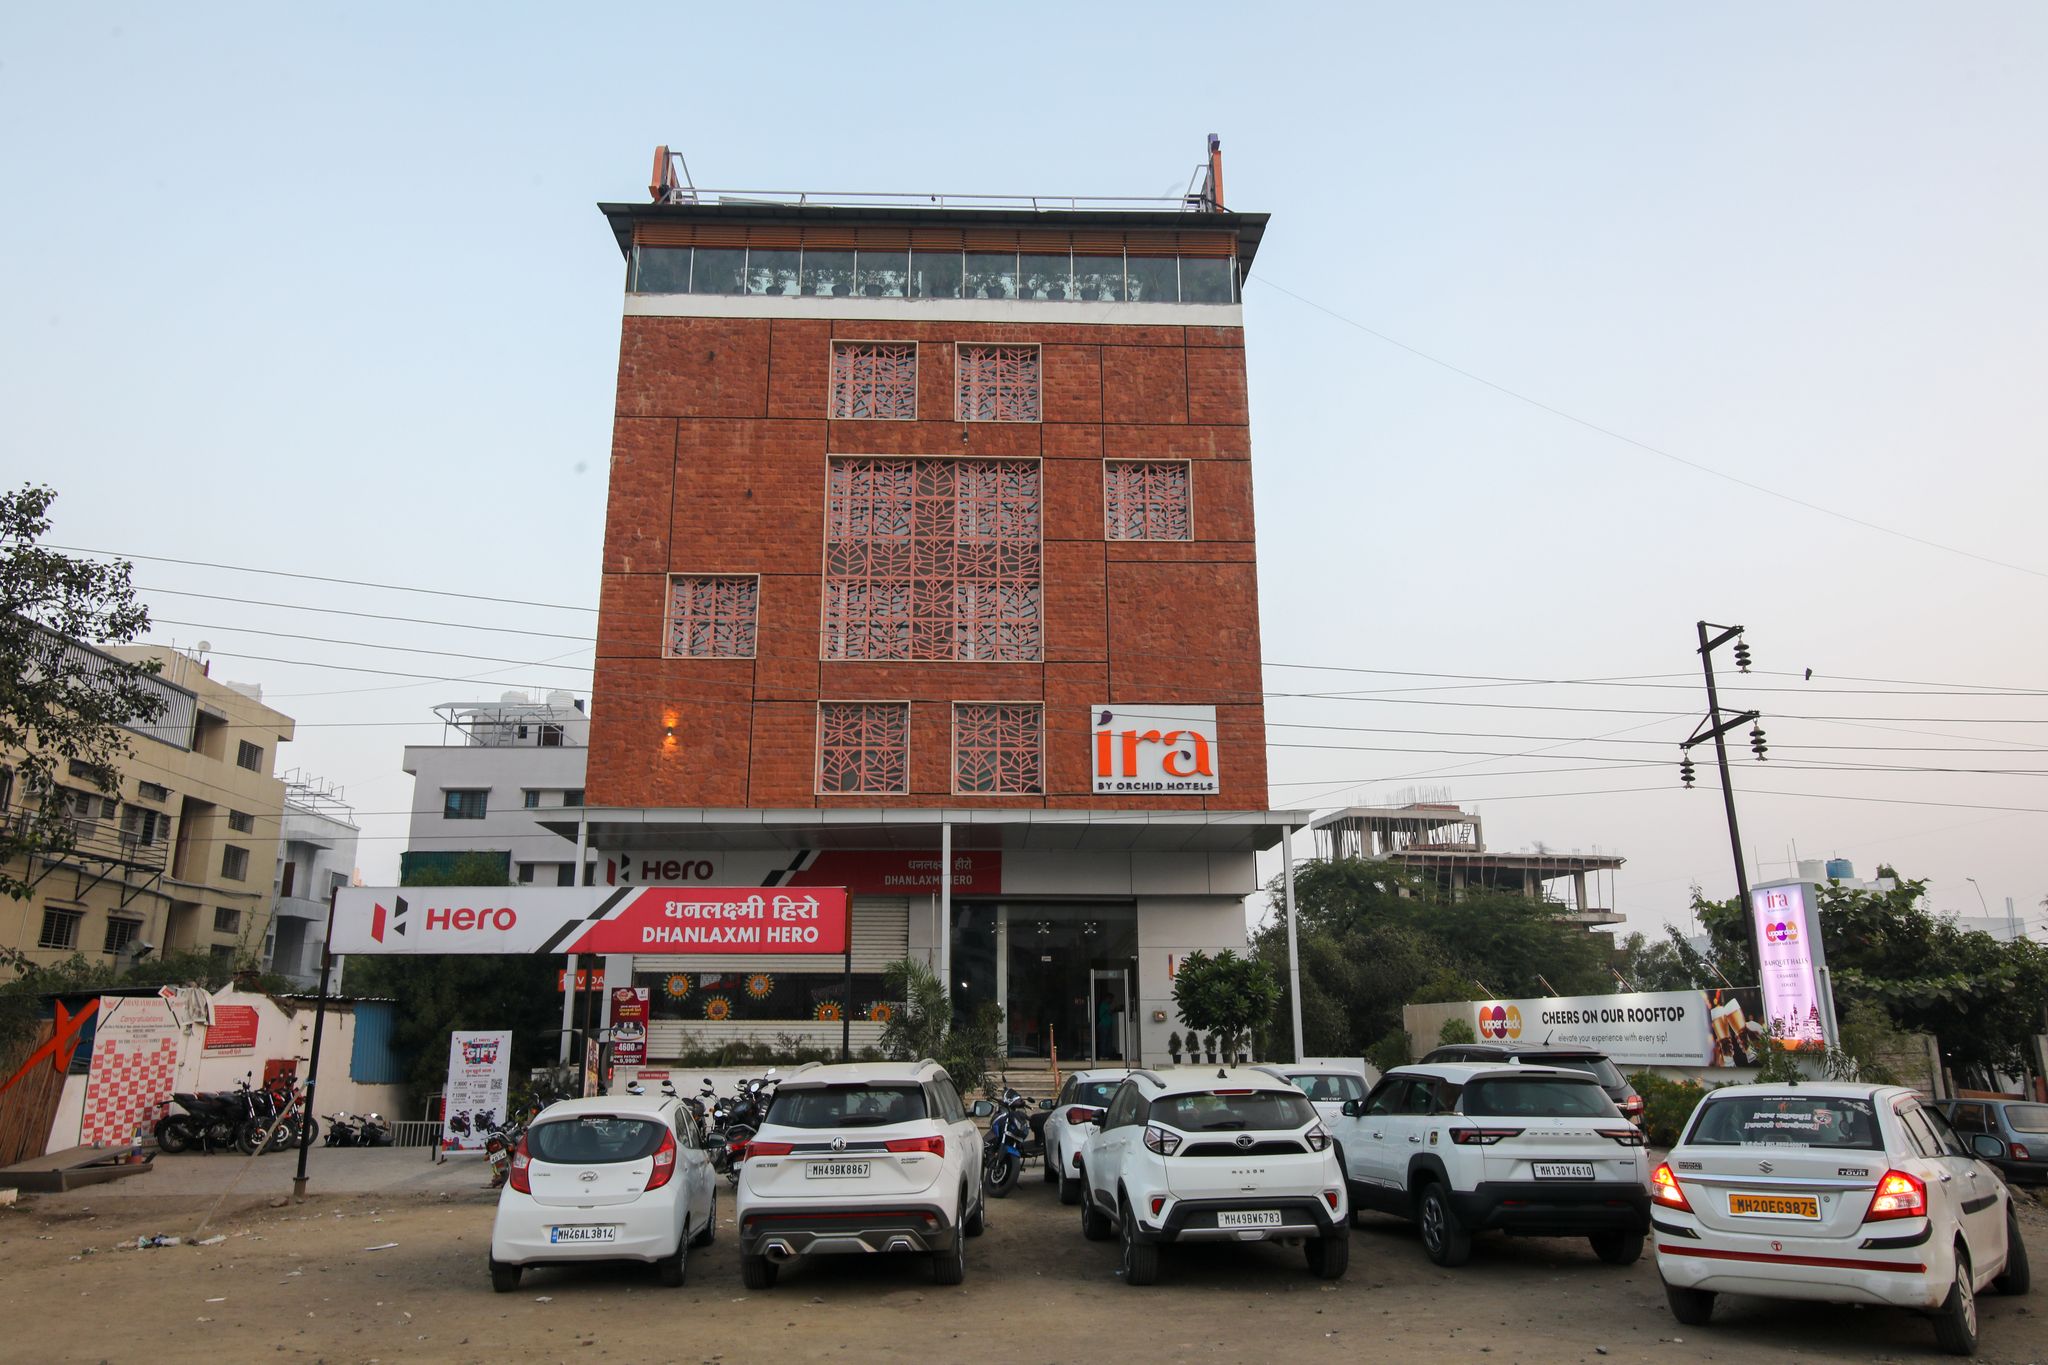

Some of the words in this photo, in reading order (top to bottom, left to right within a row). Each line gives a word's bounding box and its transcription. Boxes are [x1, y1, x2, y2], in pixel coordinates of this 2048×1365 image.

[1097, 710, 1213, 777] ira
[1098, 782, 1112, 790] BY
[1116, 782, 1163, 790] ORCHID
[1167, 782, 1213, 790] HOTELS
[1767, 891, 1788, 909] ira
[665, 894, 765, 920] धनलक्ष्मी
[772, 895, 820, 921] हिरो
[642, 926, 760, 943] DHANLAXMI
[767, 926, 819, 943] HERO
[577, 976, 604, 985] VDA
[1541, 1009, 1579, 1025] CHEERS
[1582, 1009, 1598, 1024] ON
[1601, 1008, 1625, 1023] OUR
[1628, 1006, 1685, 1023] ROOFTOP
[1482, 1019, 1503, 1033] upper
[1503, 1015, 1521, 1029] deck
[1558, 1033, 1577, 1042] elevate
[1577, 1035, 1590, 1044] your
[1591, 1033, 1624, 1044] experience
[1625, 1032, 1638, 1042] with
[1638, 1034, 1656, 1044] every
[1656, 1032, 1668, 1043] sip!
[467, 1047, 496, 1058] GIFT
[832, 1138, 845, 1150] MG
[812, 1164, 869, 1176] MH49BK8867
[1540, 1166, 1592, 1176] MH13DY4610
[1737, 1199, 1817, 1215] MH20EG9875
[1224, 1211, 1281, 1224] MH49BW6783
[557, 1227, 614, 1240] MH46AL3814
